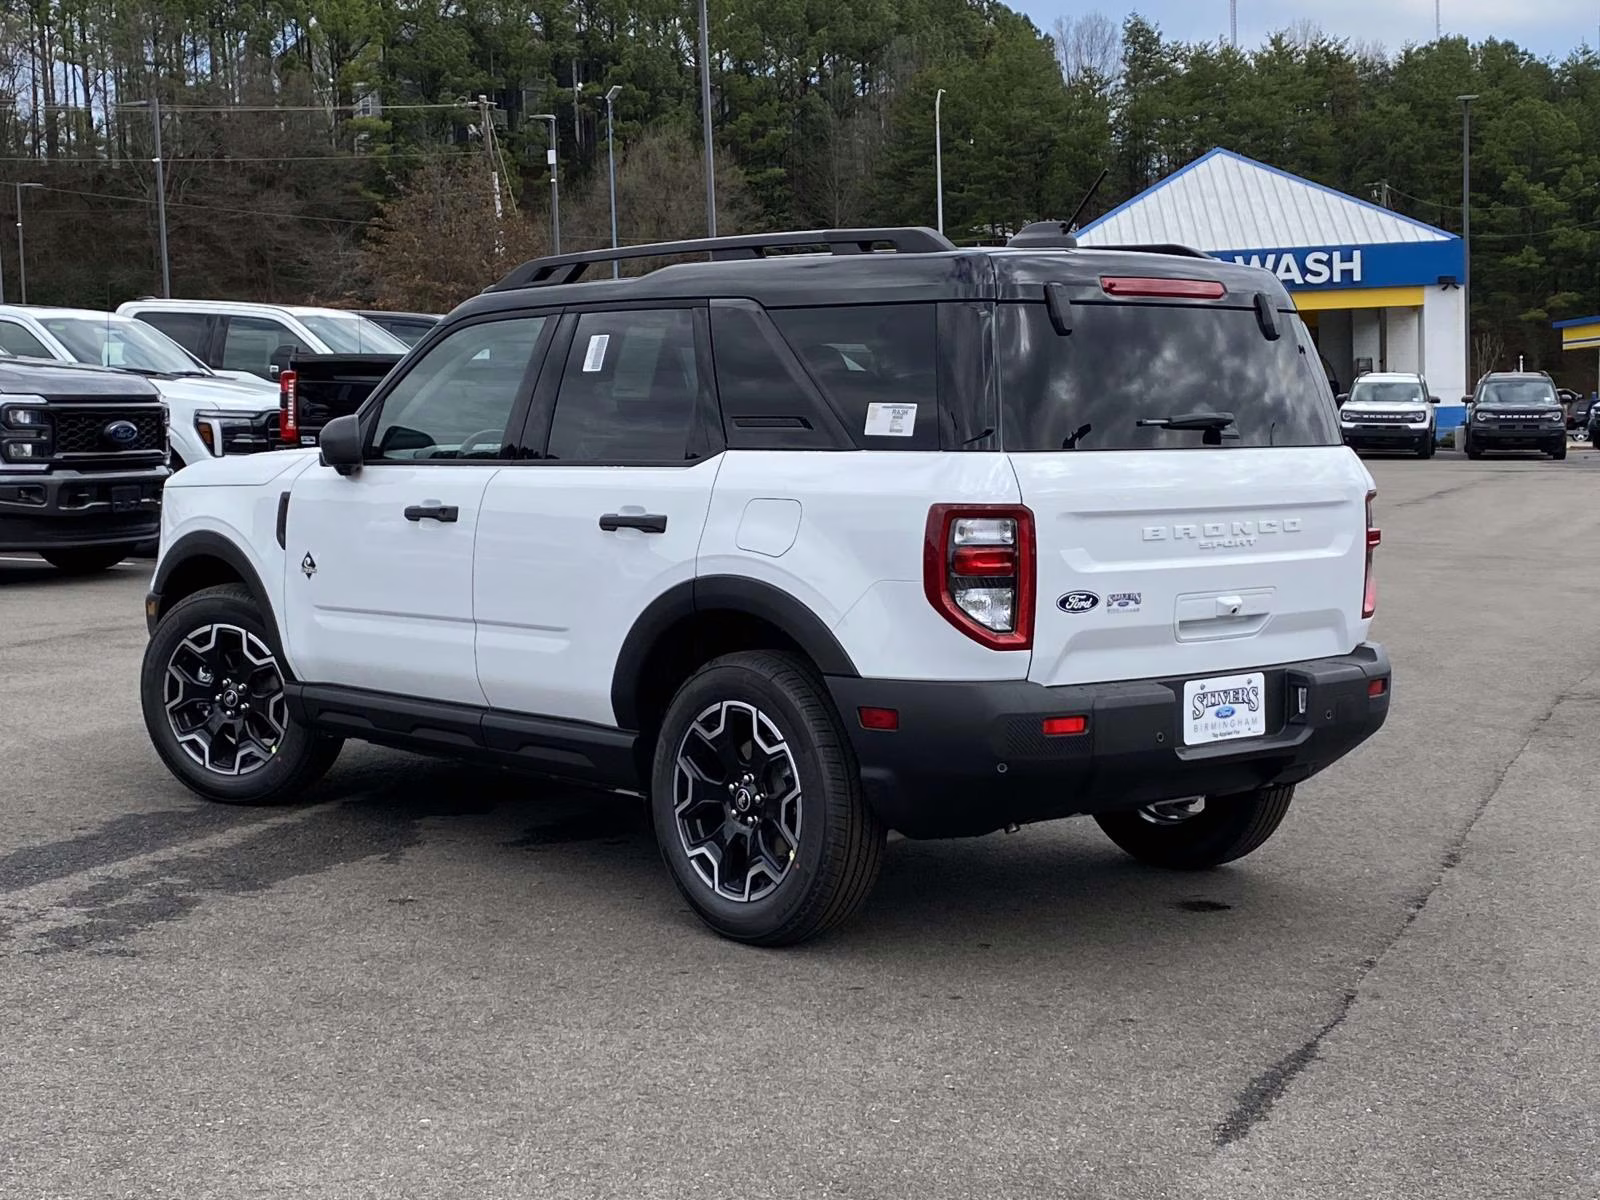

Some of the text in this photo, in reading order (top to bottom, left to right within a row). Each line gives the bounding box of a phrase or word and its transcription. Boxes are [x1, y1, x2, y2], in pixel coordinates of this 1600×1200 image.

[1142, 518, 1302, 541] BRONCO
[1199, 537, 1257, 550] SPORT
[1065, 594, 1093, 609] Ford
[1192, 686, 1260, 721] STIVERS
[1193, 718, 1259, 733] BIRMINGHAM
